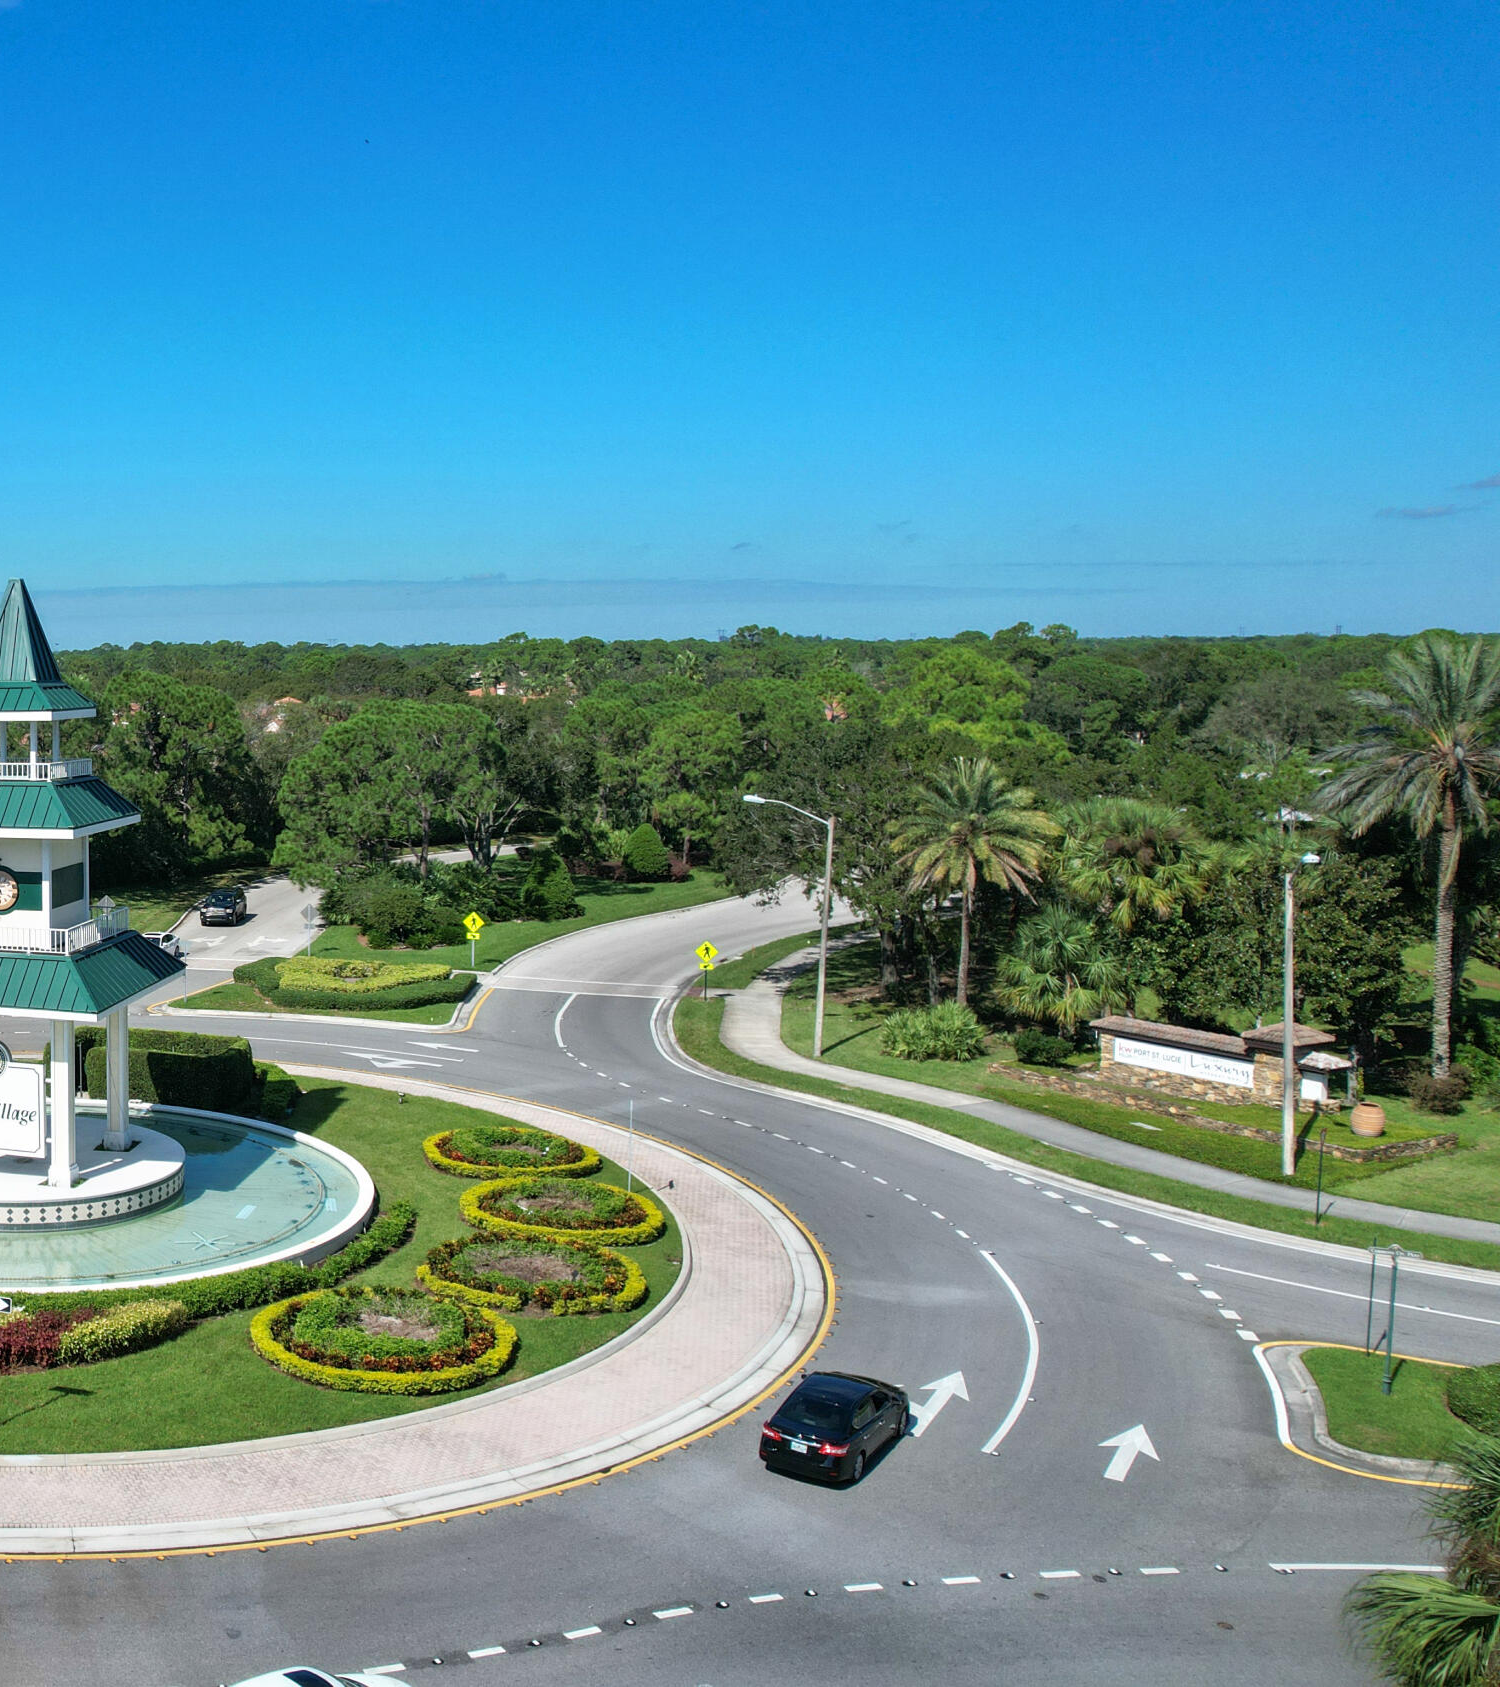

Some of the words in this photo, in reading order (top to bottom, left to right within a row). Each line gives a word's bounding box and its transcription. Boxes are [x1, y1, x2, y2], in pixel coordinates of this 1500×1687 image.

[1133, 1047, 1150, 1057] PORT
[1162, 1054, 1181, 1064] LUCIE
[1190, 1054, 1250, 1084] Luxury
